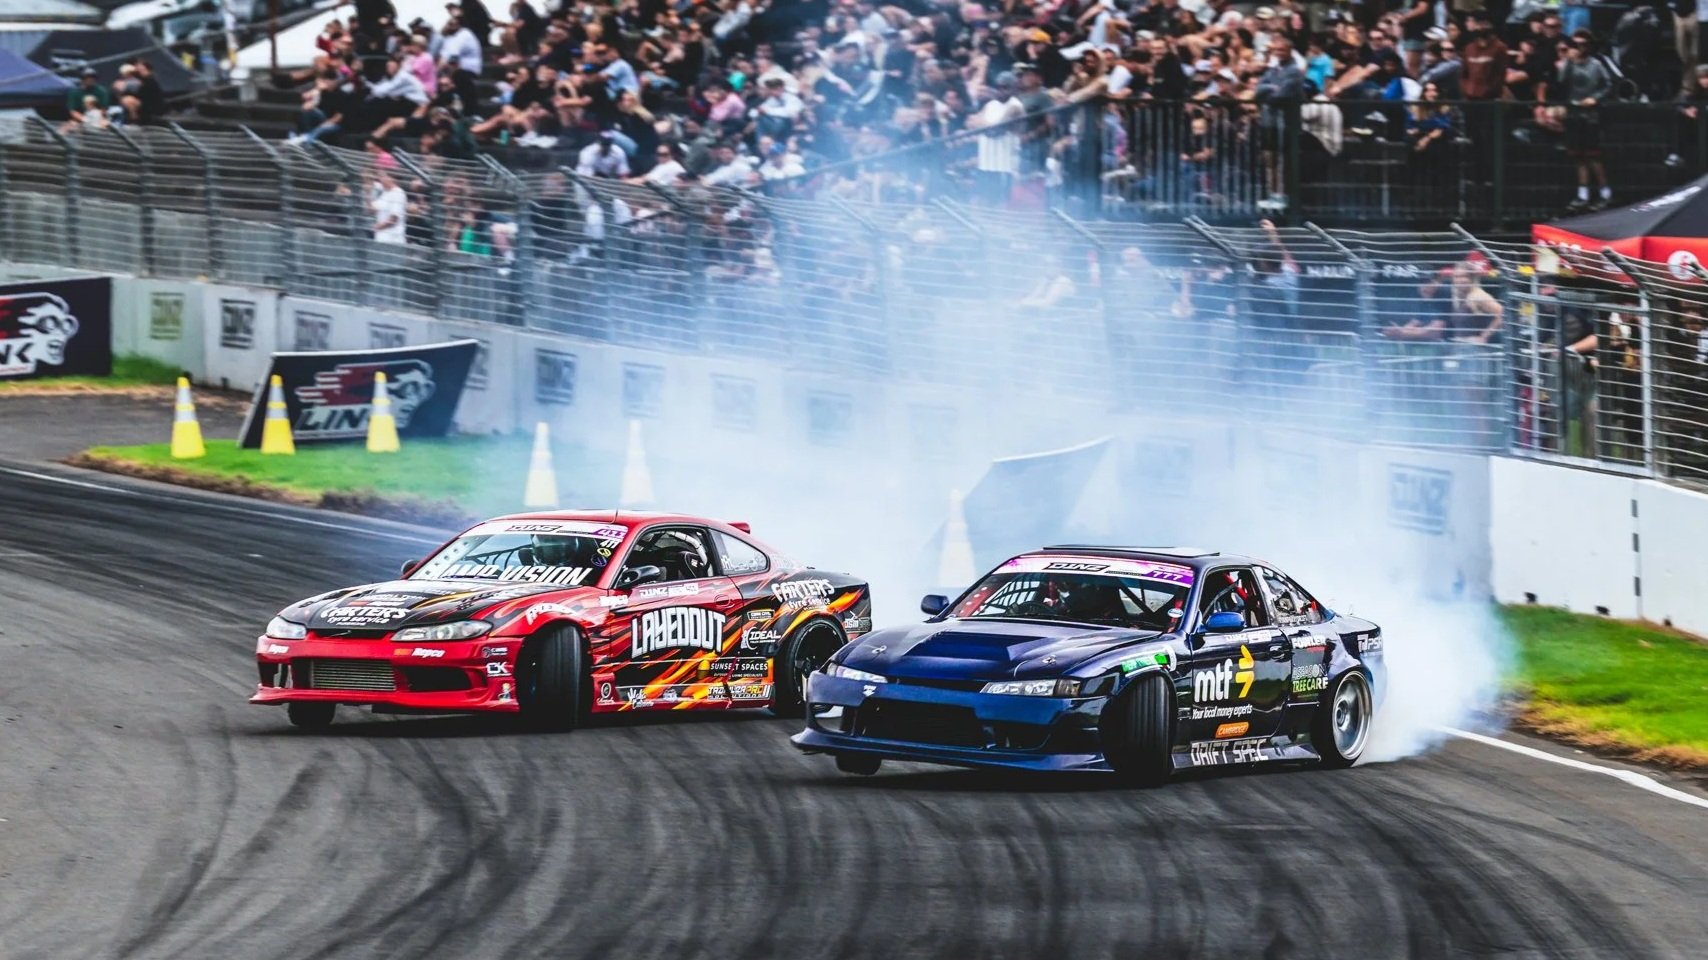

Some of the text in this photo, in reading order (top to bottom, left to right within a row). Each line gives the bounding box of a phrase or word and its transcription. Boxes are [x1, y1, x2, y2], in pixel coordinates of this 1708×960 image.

[294, 408, 370, 431] LIN
[498, 565, 593, 586] VISION
[1047, 562, 1107, 572] DINZ
[1153, 570, 1184, 581] 777
[749, 630, 782, 640] IDEAL
[741, 663, 768, 671] SPACES
[1194, 658, 1233, 703] mtf
[1192, 703, 1253, 720] Your local money experts
[1191, 738, 1269, 767] DRIFT SPEC
